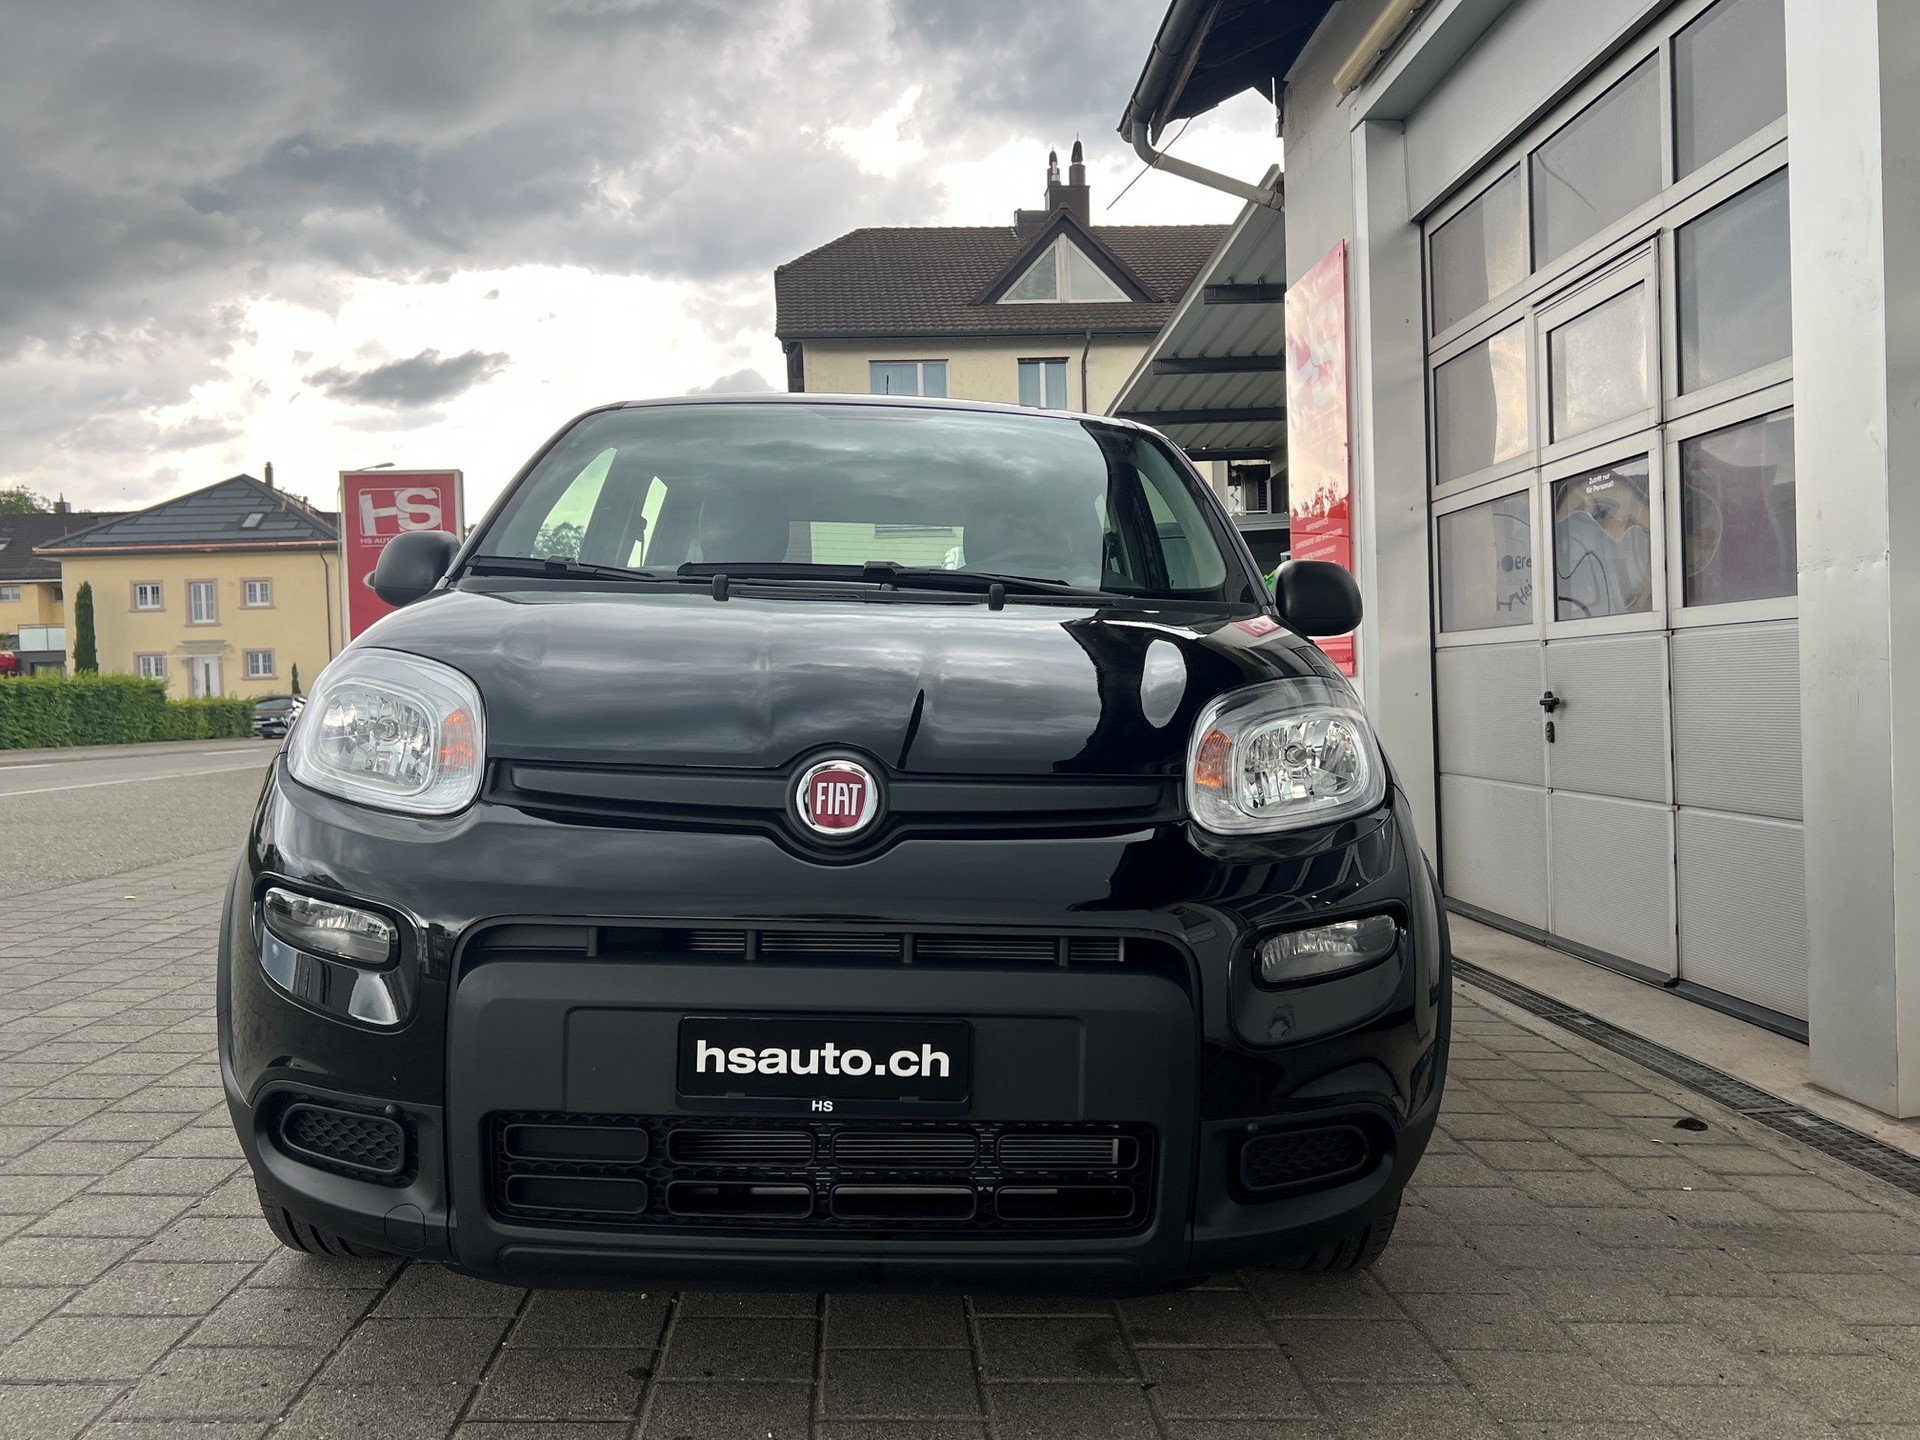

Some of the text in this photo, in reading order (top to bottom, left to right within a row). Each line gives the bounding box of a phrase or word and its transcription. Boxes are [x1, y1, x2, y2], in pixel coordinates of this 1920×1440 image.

[360, 487, 442, 536] HS
[816, 782, 862, 815] FIAT
[696, 1039, 950, 1077] hsauto.ch
[811, 1100, 834, 1112] HS
